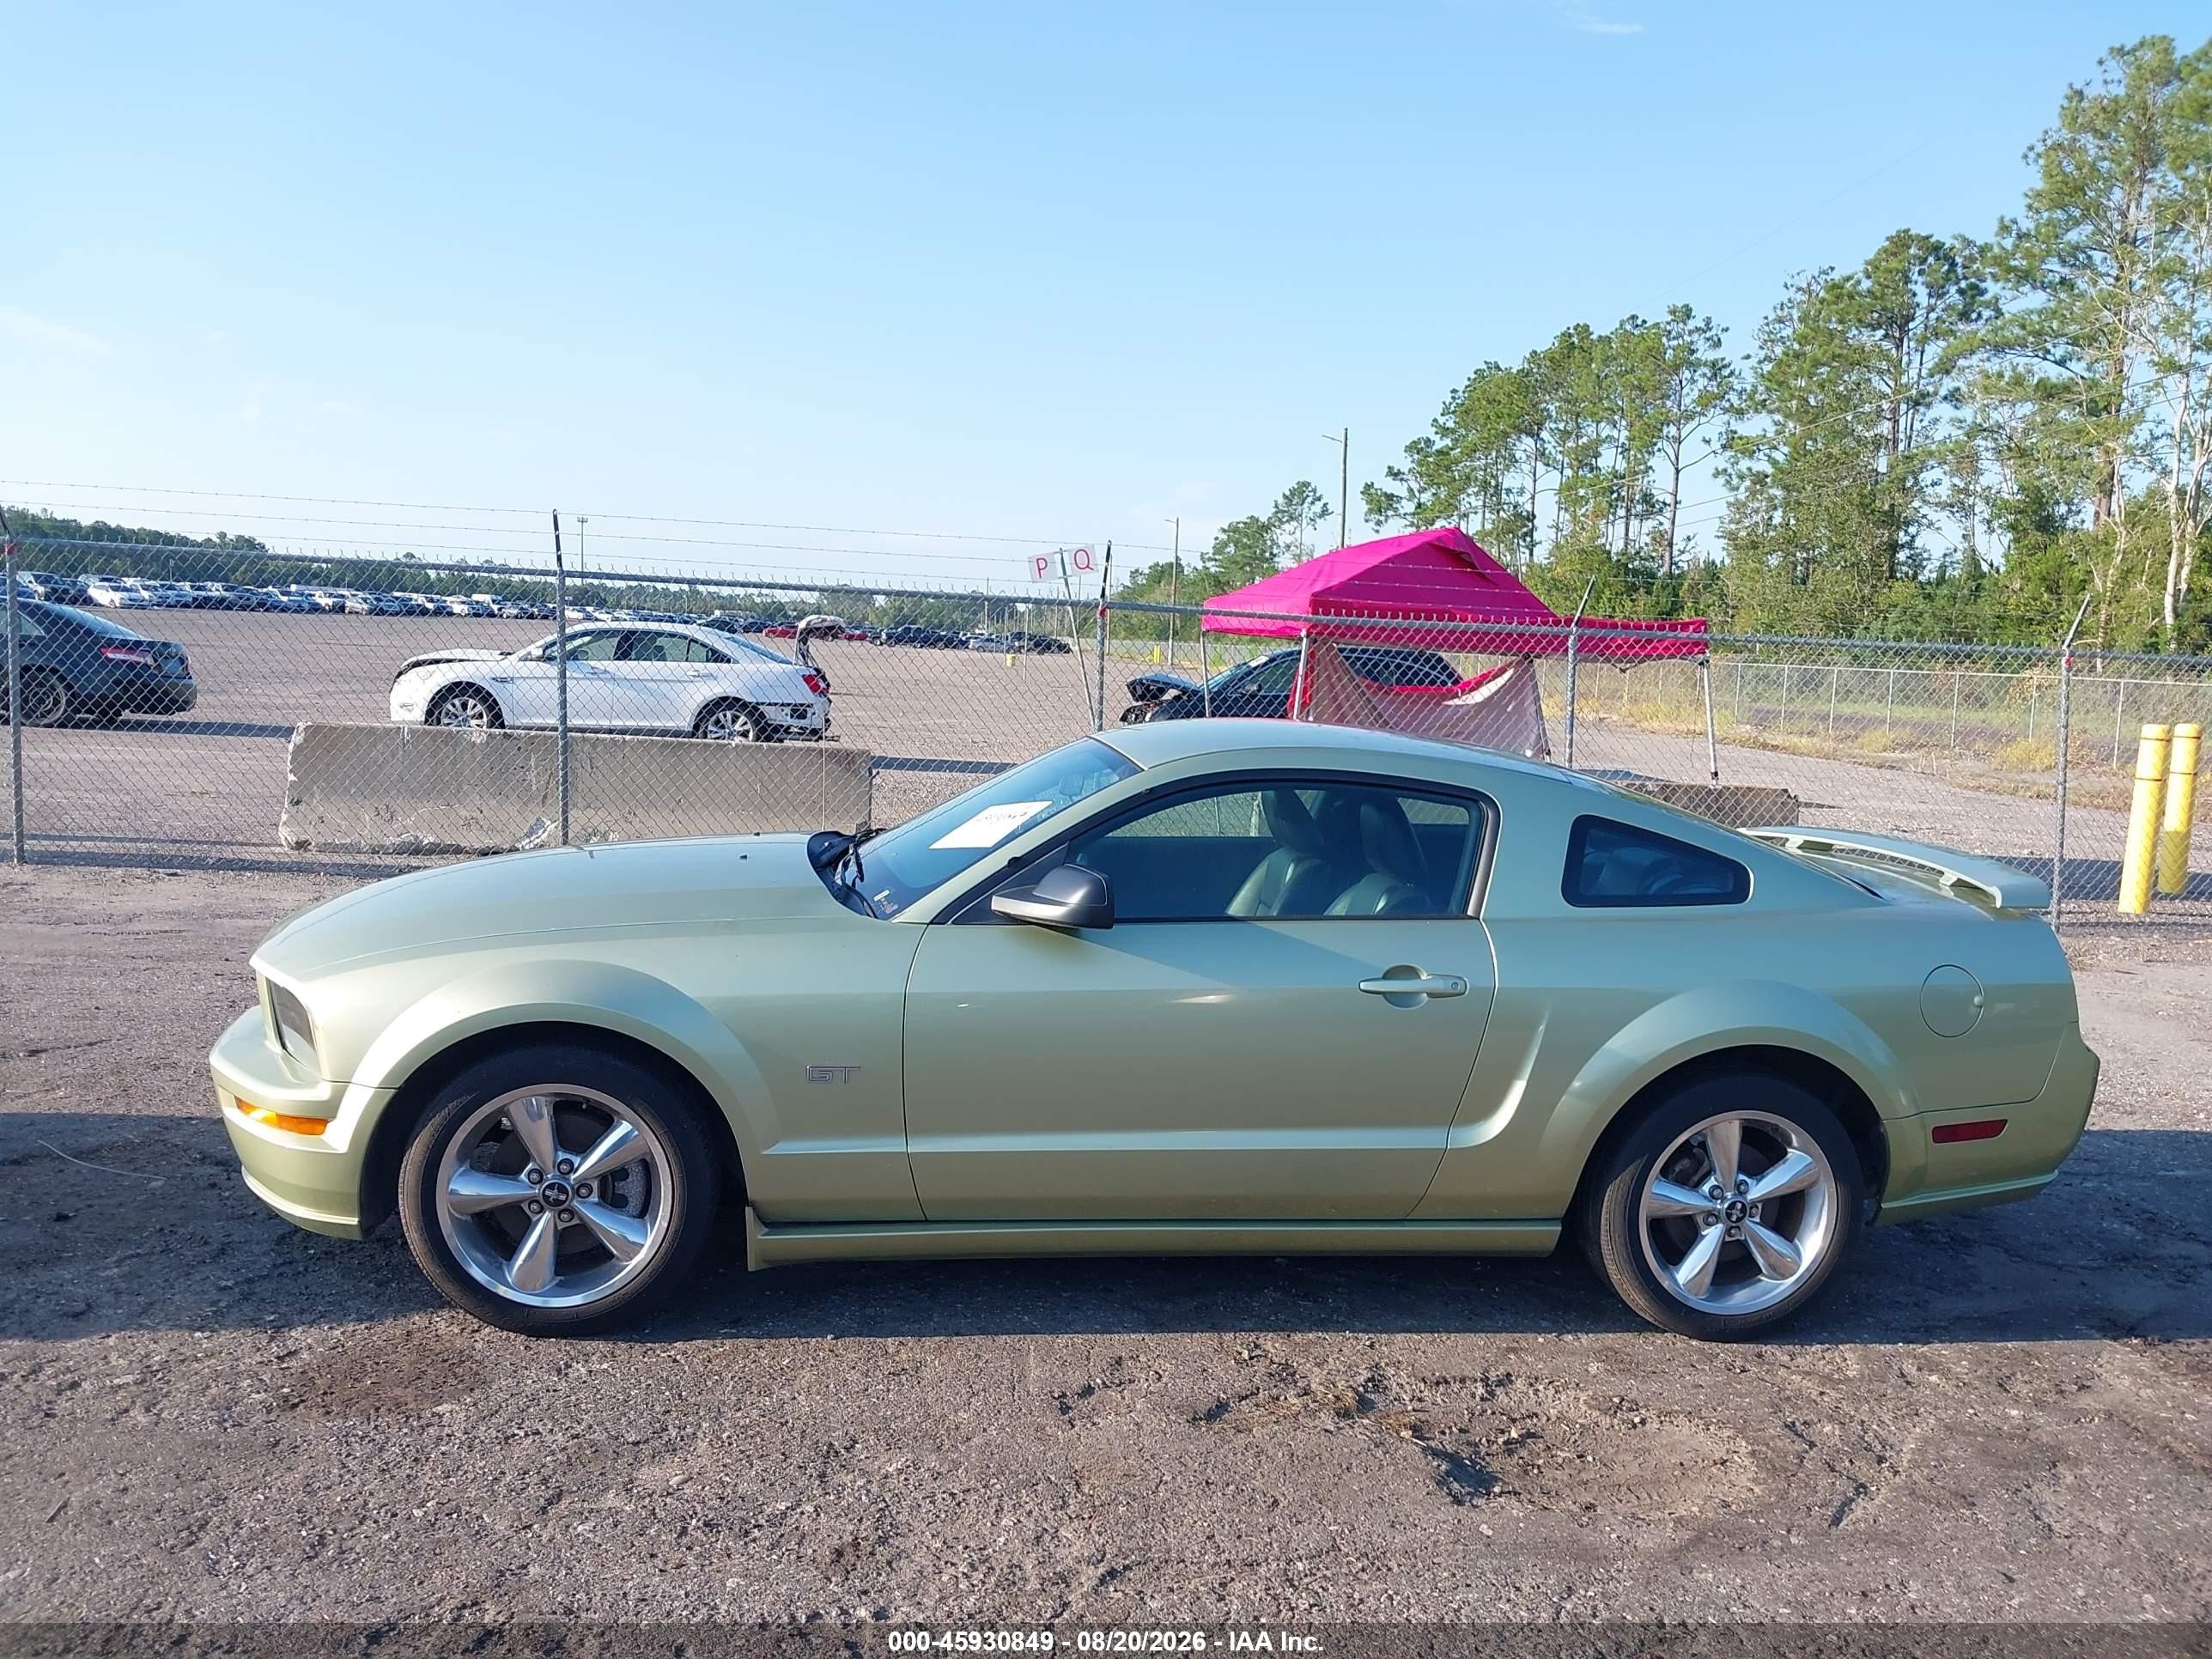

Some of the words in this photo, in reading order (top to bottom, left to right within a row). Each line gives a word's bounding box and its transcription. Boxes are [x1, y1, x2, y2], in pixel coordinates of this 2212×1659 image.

[1036, 557, 1048, 579] P
[1074, 549, 1094, 571] Q
[805, 1064, 860, 1084] GT
